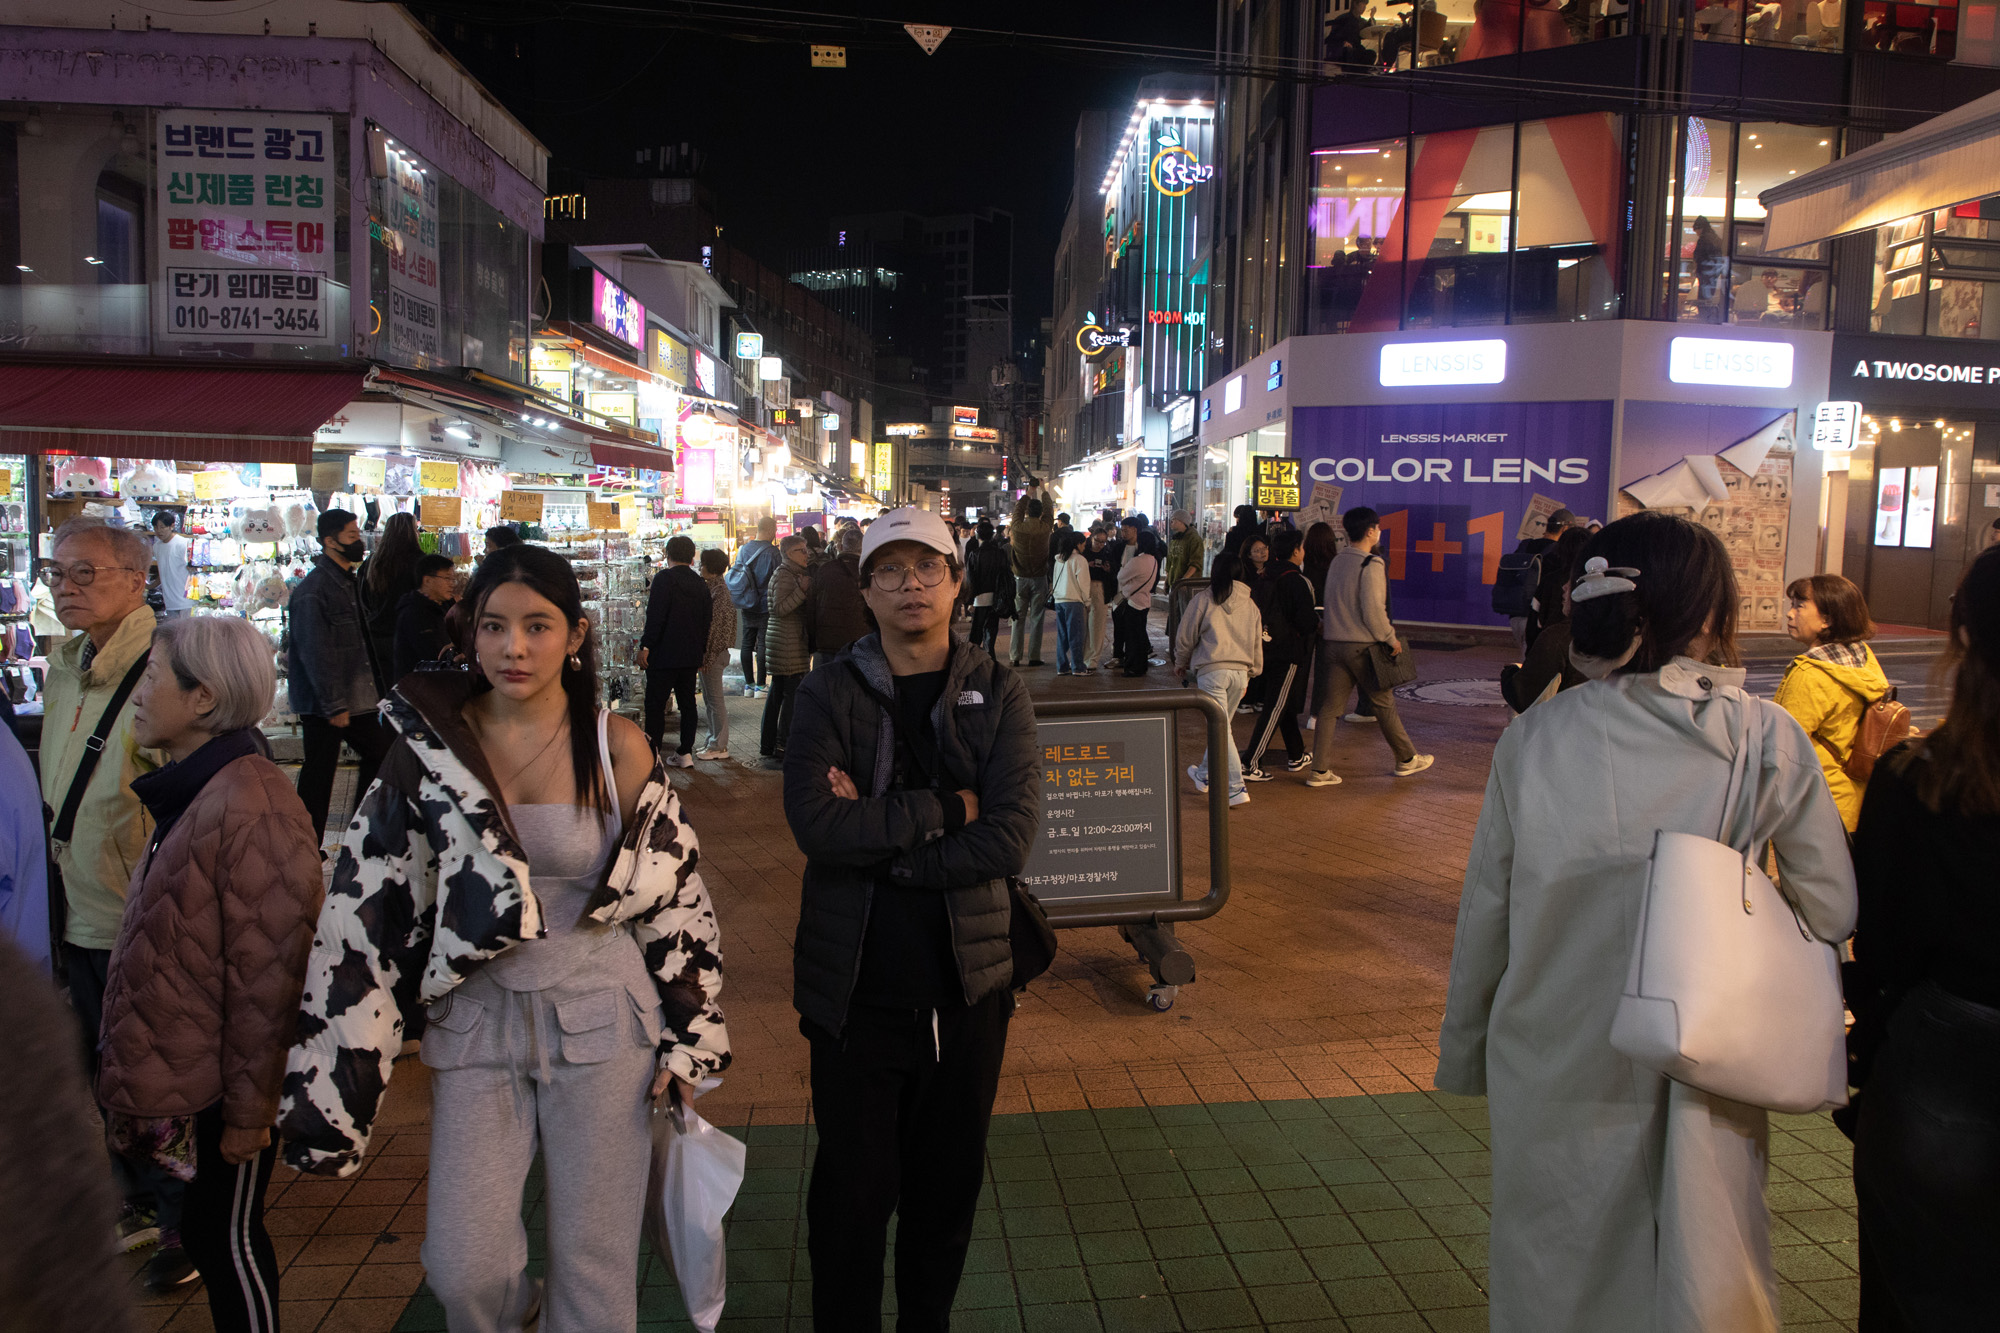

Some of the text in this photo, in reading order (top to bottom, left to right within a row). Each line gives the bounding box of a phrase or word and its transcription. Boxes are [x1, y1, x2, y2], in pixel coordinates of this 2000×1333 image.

[165, 125, 325, 162] 브랜드 광고
[167, 172, 324, 209] 신제품 런칭
[168, 218, 324, 254] 팝업 스토어
[409, 252, 437, 289] 스토어
[175, 273, 319, 301] 단기 임대문의
[175, 305, 320, 331] 010-8741-3454
[1148, 310, 1182, 324] ROOM
[1089, 327, 1130, 347] 오렌지룸
[1402, 354, 1484, 373] LENSSIS
[1693, 352, 1772, 373] LENSSIS
[1854, 360, 1869, 377] A
[1873, 361, 1983, 384] TWOSOME
[1381, 433, 1508, 443] LENSSIS MARKET
[1260, 461, 1299, 485] 반값
[1308, 458, 1589, 484] COLOR LENS
[1259, 489, 1298, 505] 방탈출
[1379, 509, 1504, 585] 1+1
[1045, 745, 1111, 763] 레드로드
[1046, 765, 1134, 786] 차 없는 거리
[1046, 791, 1065, 801] 걸으면
[1094, 789, 1113, 798] 마포가
[1115, 787, 1154, 797] 행복해집니다.
[1046, 809, 1075, 819] 운영시간
[1047, 822, 1152, 839] 금.토.일 12:00~23:00까지
[1025, 871, 1118, 885] 마포구청장/마포경찰서장
